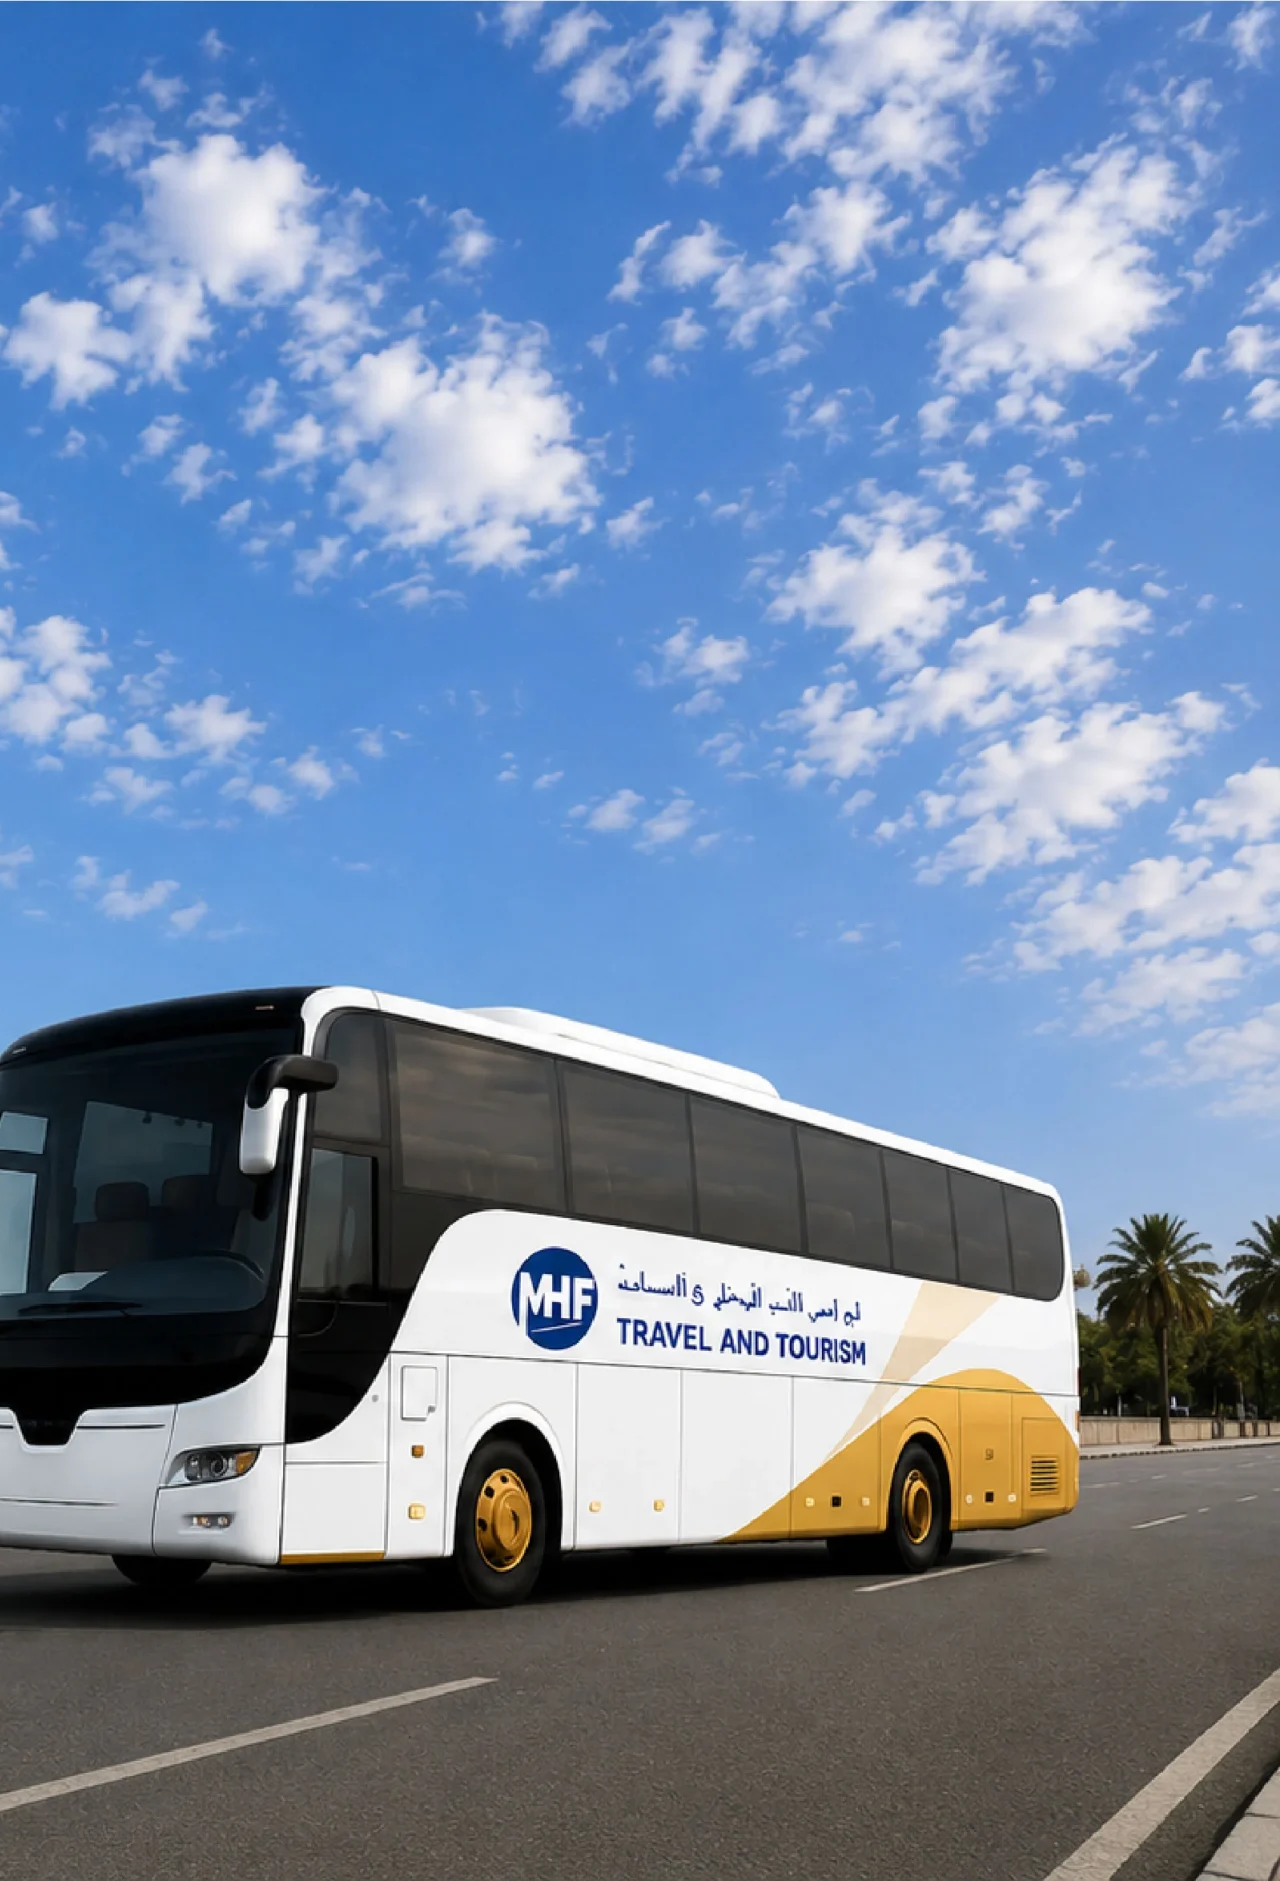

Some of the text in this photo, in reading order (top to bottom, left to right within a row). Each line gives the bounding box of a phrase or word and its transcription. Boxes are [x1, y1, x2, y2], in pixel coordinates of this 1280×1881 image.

[520, 1271, 595, 1321] MHF
[617, 1317, 867, 1366] TRAVEL AND TOURISM
